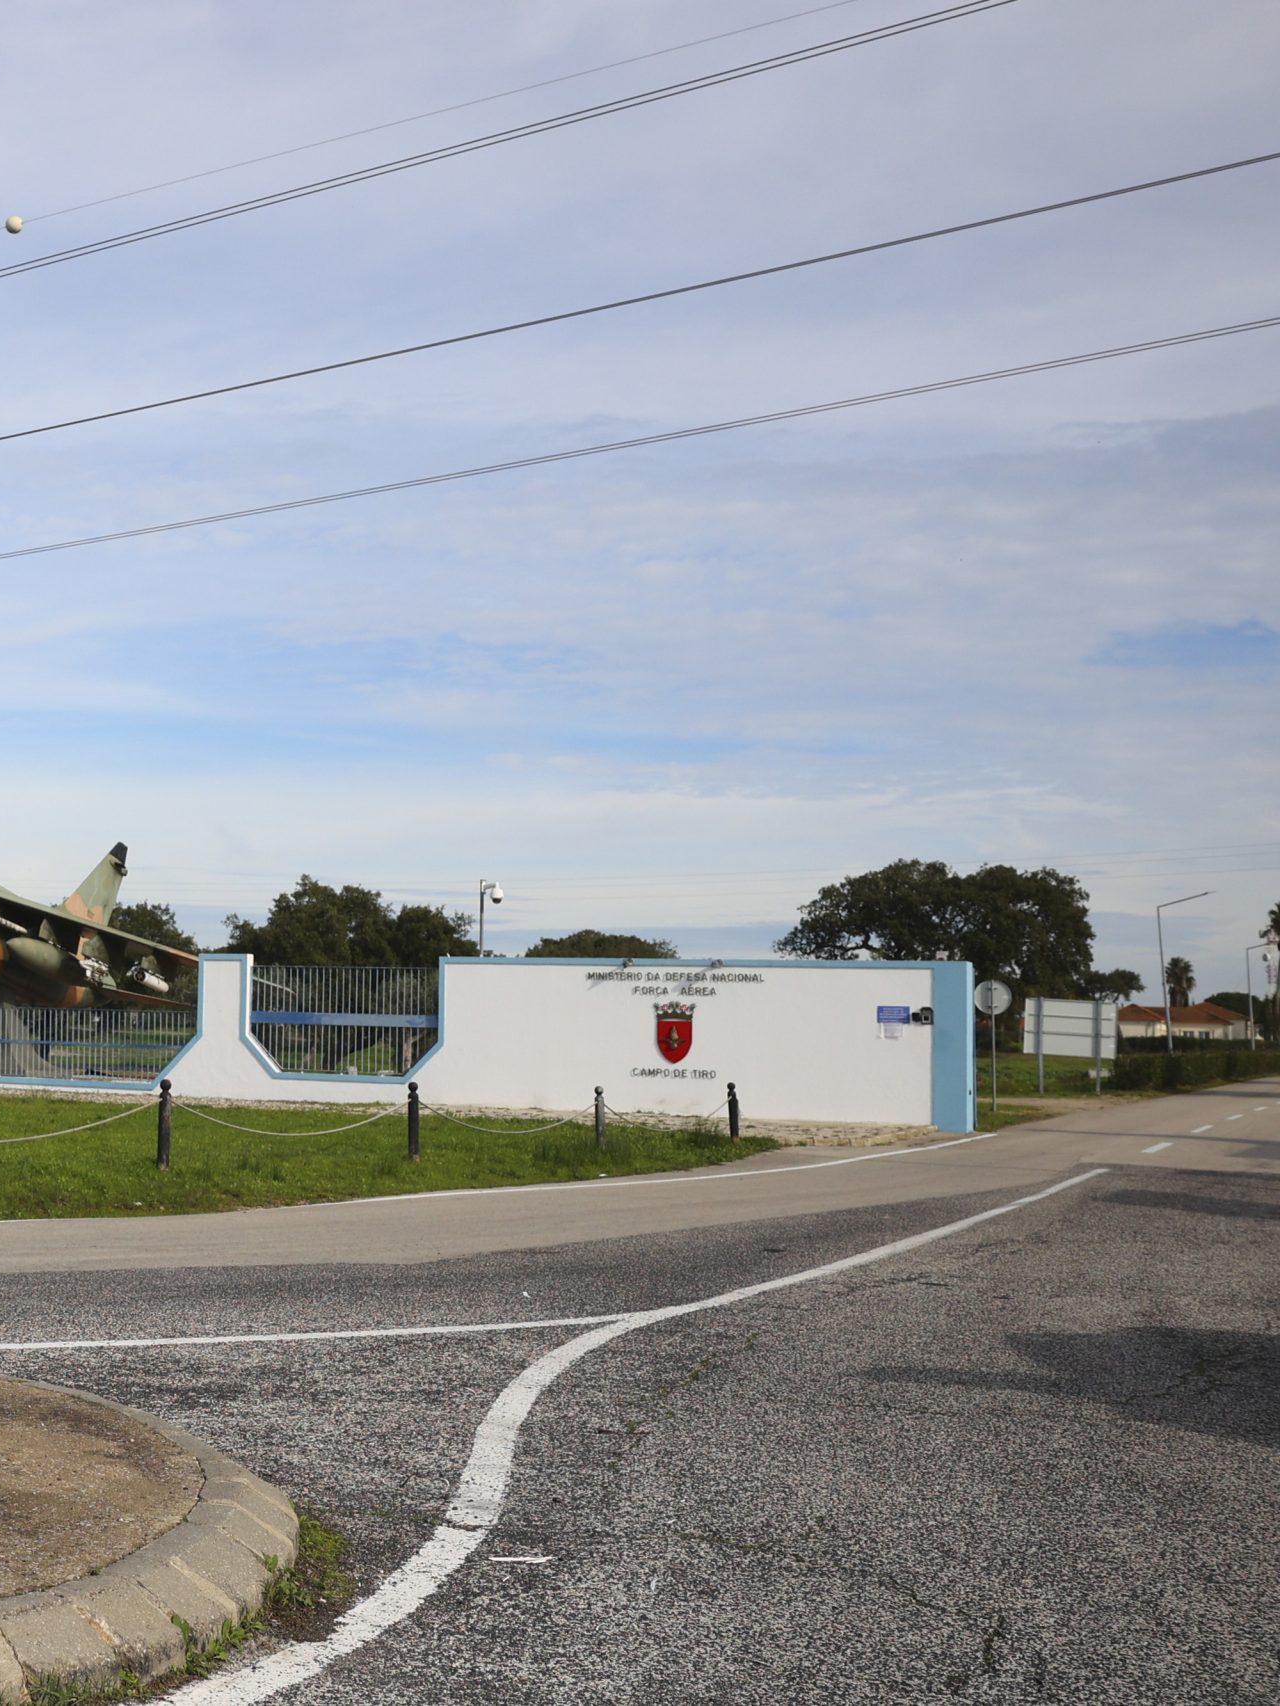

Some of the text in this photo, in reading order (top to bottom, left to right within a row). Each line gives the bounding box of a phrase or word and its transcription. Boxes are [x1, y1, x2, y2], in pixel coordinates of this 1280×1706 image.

[647, 972, 661, 982] DA
[665, 972, 708, 982] DEFESA
[711, 972, 765, 983] NACIONAL
[634, 984, 716, 996] FORÇA AÉREA
[632, 1067, 716, 1079] CAMPO DE TIRO
